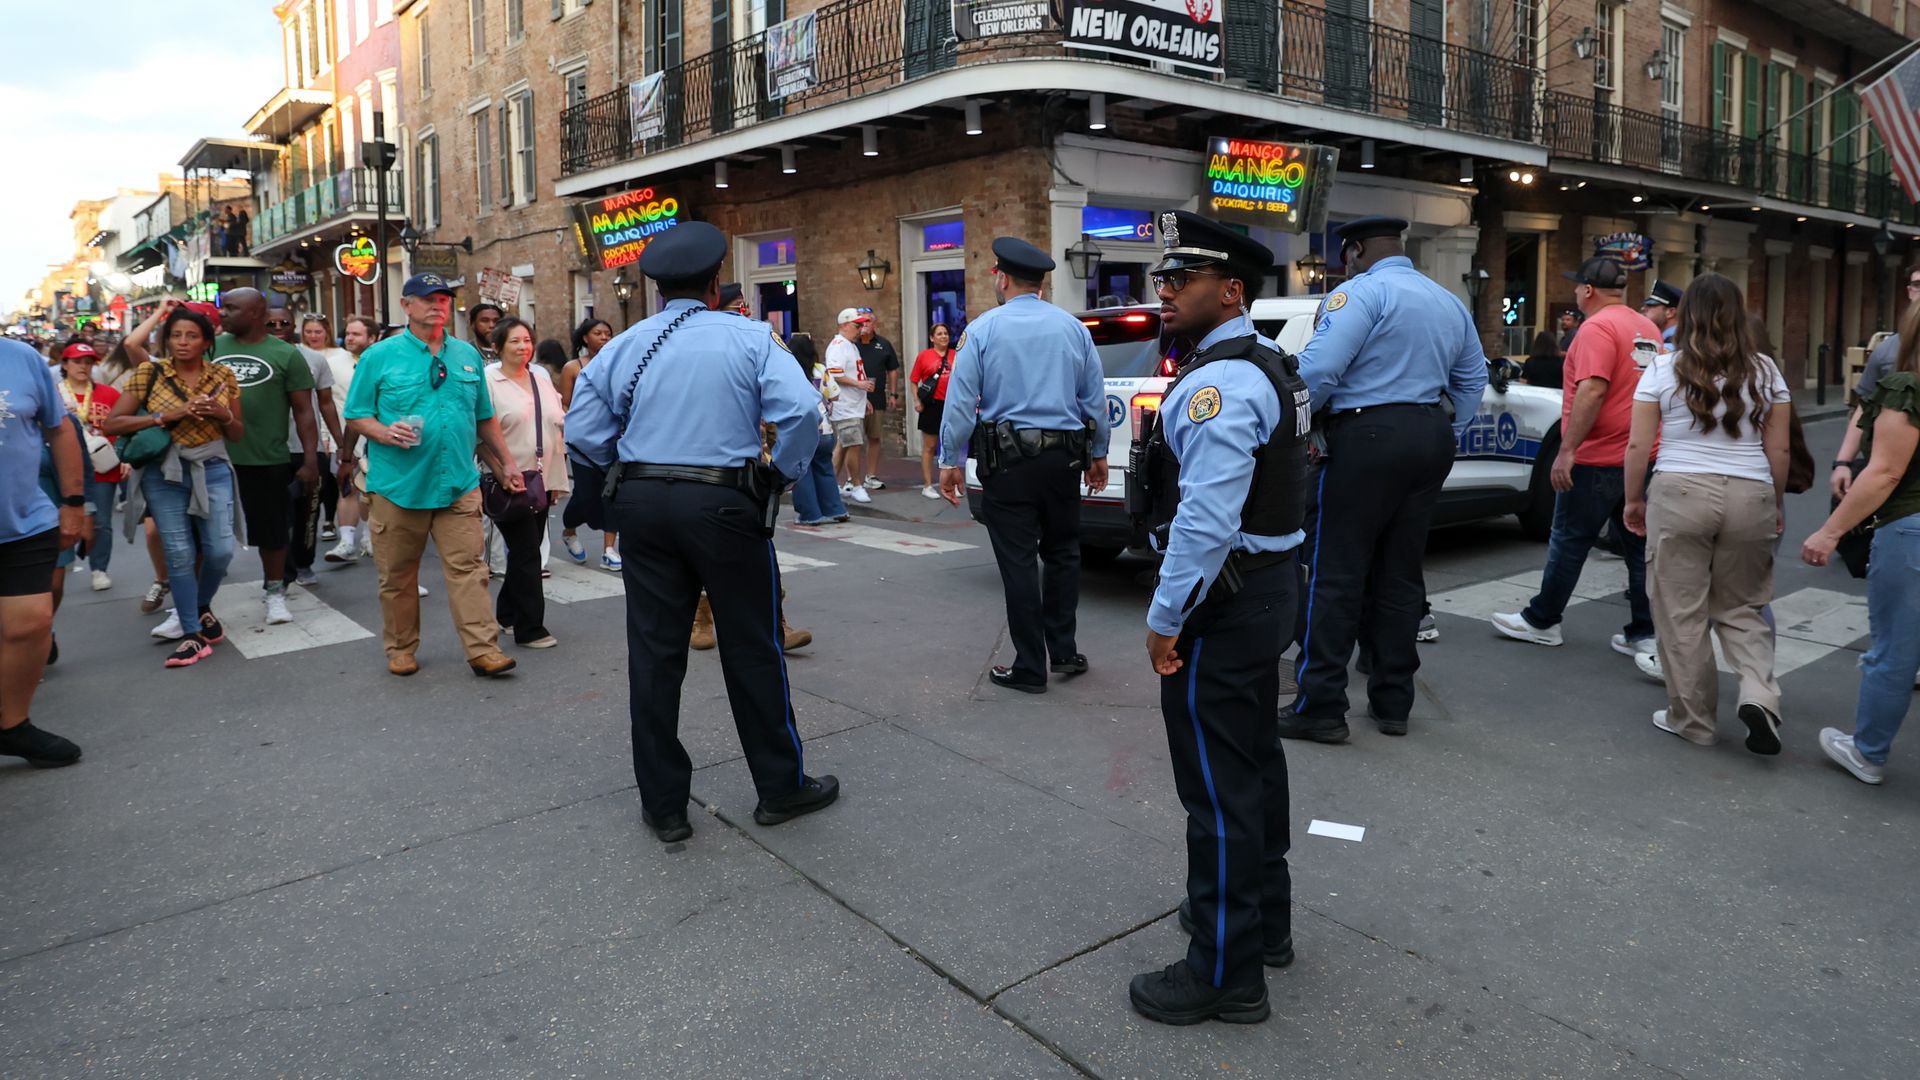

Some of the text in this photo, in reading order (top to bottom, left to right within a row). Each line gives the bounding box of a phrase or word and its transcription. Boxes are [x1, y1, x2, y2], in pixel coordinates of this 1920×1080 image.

[973, 3, 1048, 24] CELEBRATIONS IN
[980, 17, 1042, 37] NEW ORLEANS
[1070, 7, 1220, 62] NEW ORLEANS
[1228, 141, 1284, 159] MANGO
[1208, 154, 1304, 188] MANGO
[604, 187, 654, 211] MANGO
[1213, 180, 1292, 203] DAIQUIRIS
[592, 198, 678, 233] MANGO
[1214, 197, 1255, 210] COCKTAILS
[1266, 201, 1288, 213] BEER
[604, 218, 677, 246] DAIQUIRIS
[1600, 232, 1643, 245] OCEANA
[604, 239, 646, 259] COCKTAILS
